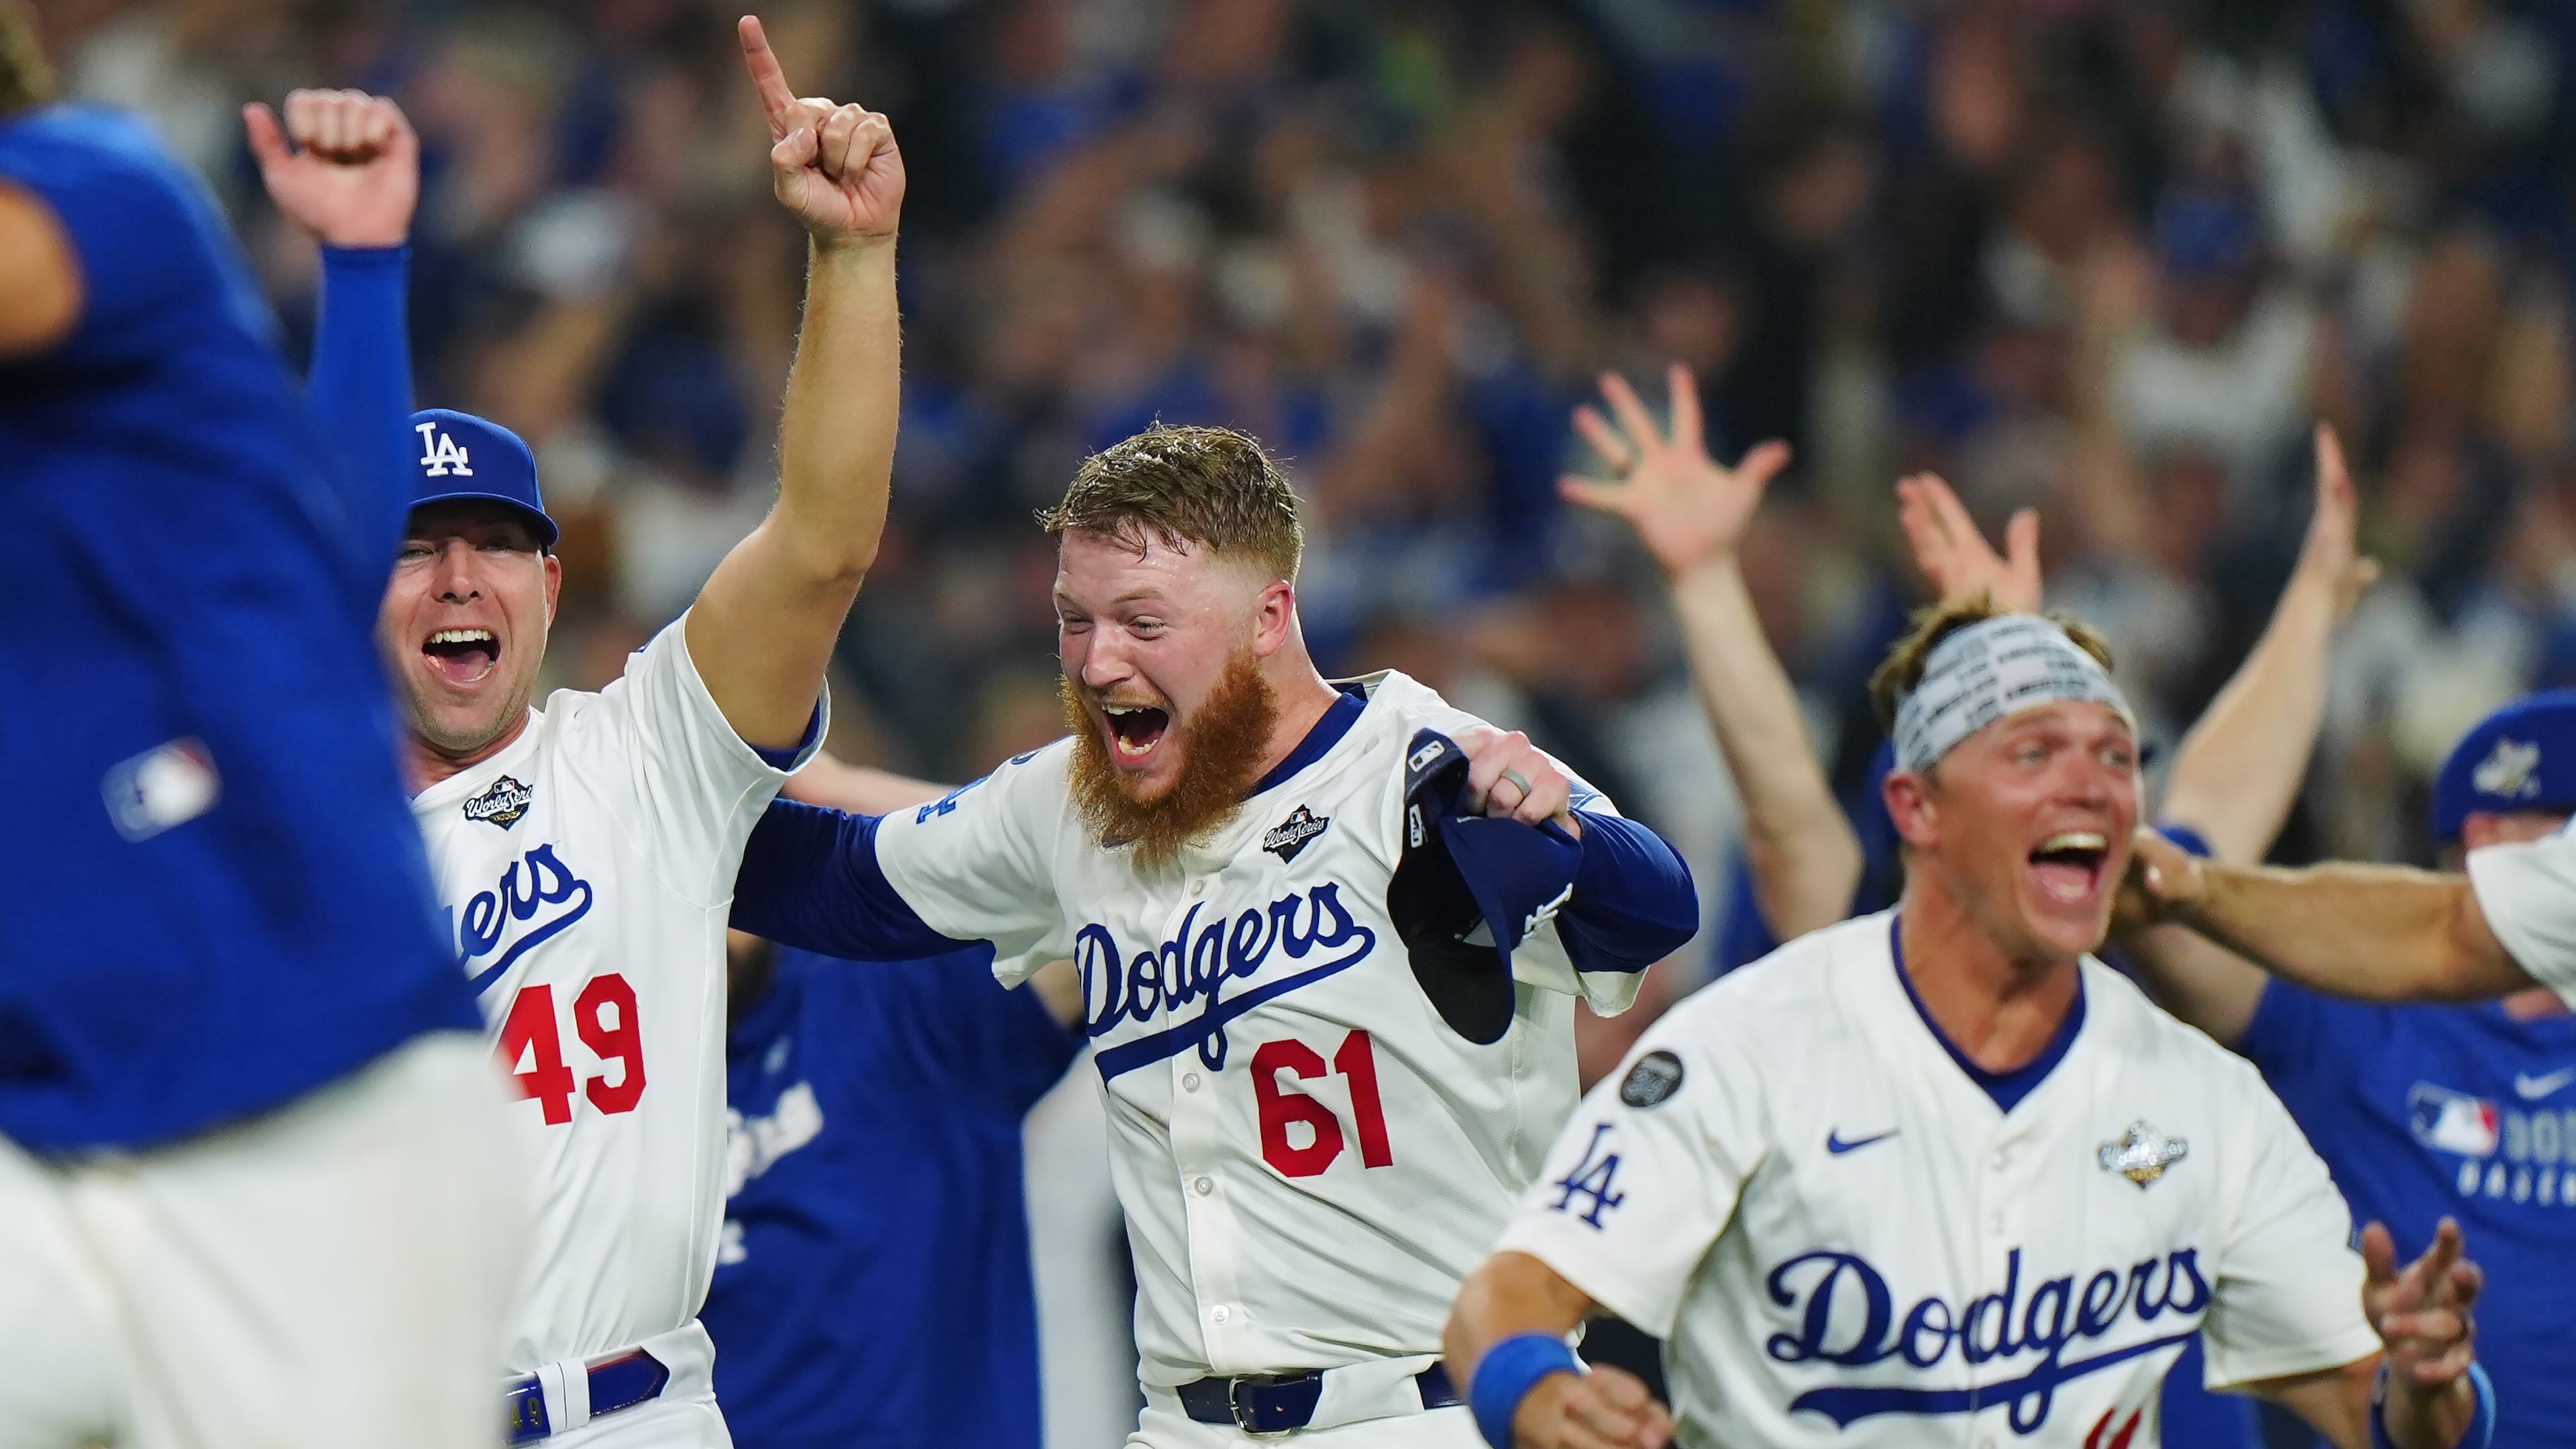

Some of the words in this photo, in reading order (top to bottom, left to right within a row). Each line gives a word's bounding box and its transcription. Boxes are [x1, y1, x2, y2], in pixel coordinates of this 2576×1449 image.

[415, 421, 474, 477] LA
[466, 792, 509, 818] World
[1264, 825, 1297, 849] World
[1290, 817, 1326, 845] Series
[1074, 881, 1375, 1073] Dodgers
[492, 973, 647, 1126] 49
[1250, 1029, 1393, 1178] 61
[1548, 1123, 1625, 1230] LA
[1767, 1246, 2211, 1436] Dodgers
